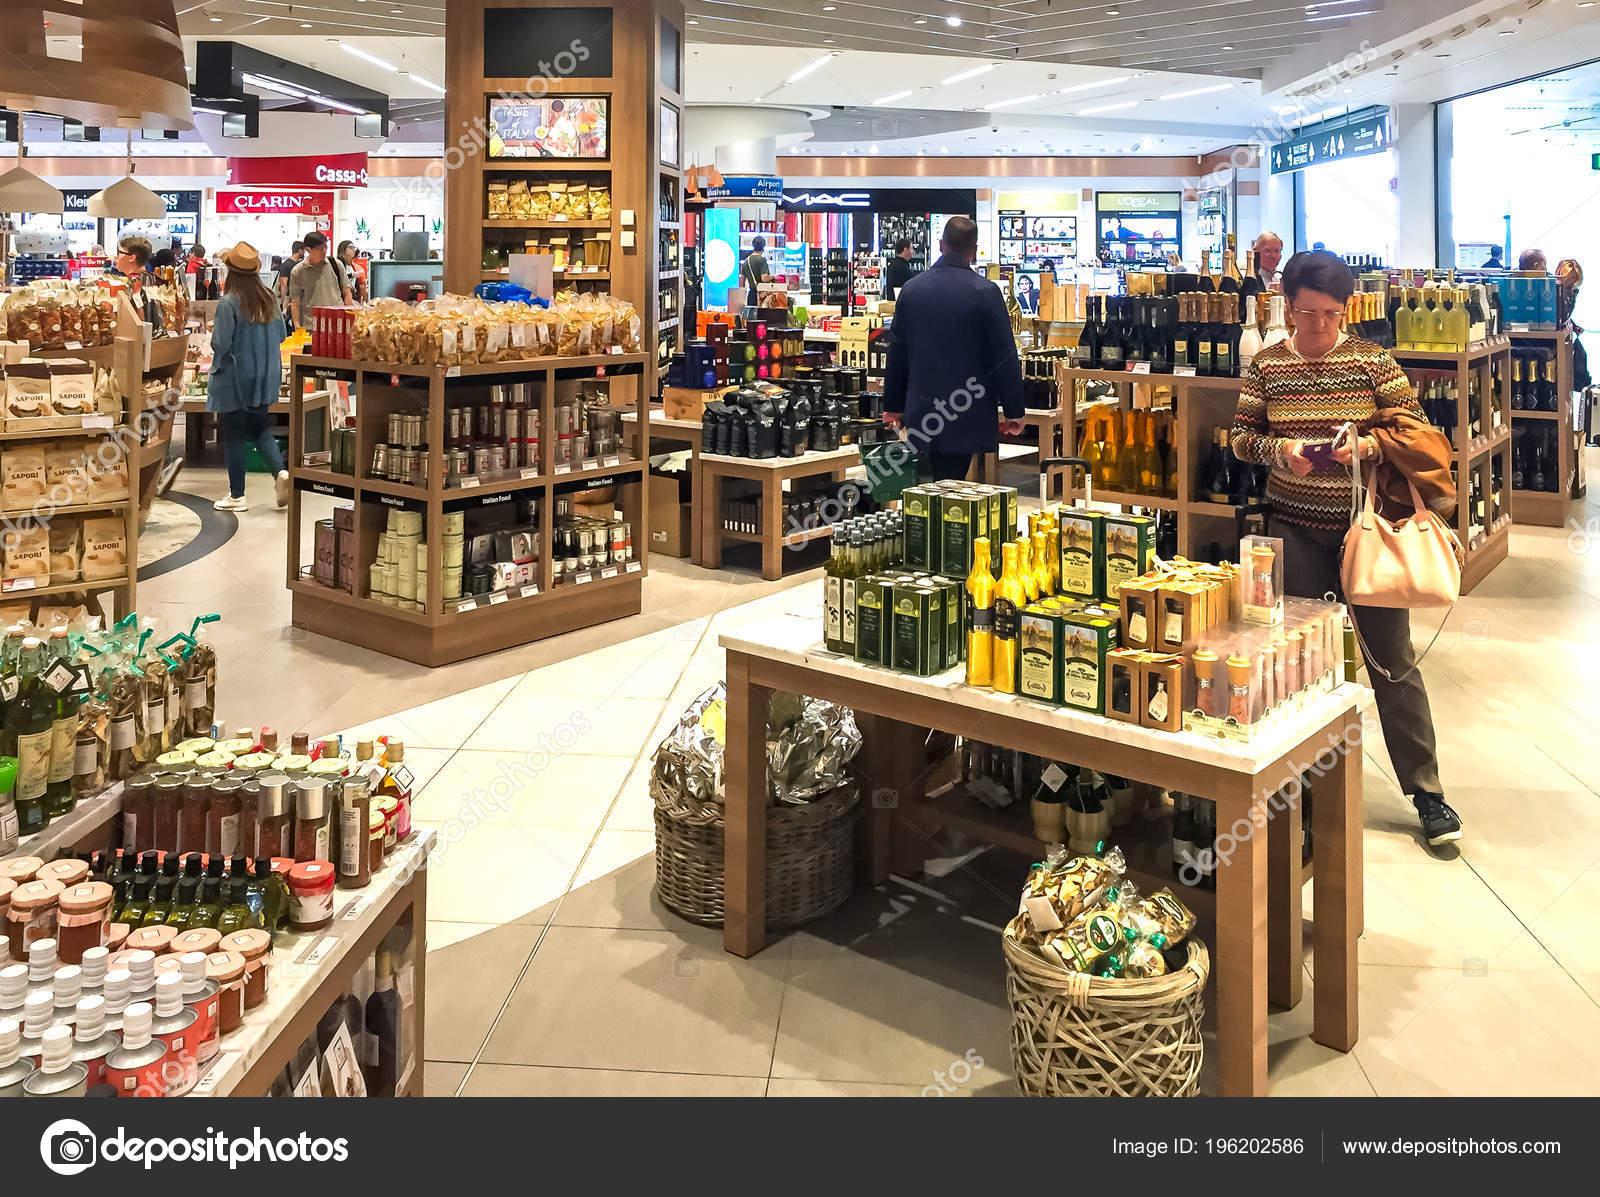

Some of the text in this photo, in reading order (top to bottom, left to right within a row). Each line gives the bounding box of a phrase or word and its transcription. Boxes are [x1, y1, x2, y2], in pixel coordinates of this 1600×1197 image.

[502, 106, 529, 118] TASTE
[501, 128, 531, 140] ITALY
[757, 179, 780, 190] Airport
[234, 195, 313, 208] CLARIN
[15, 394, 43, 402] SAPORI
[58, 392, 86, 400] SAPORI
[11, 472, 39, 480] SAPORI
[482, 494, 512, 504] Italian Food
[92, 542, 120, 551] SAPORI
[13, 552, 42, 560] SAPORI
